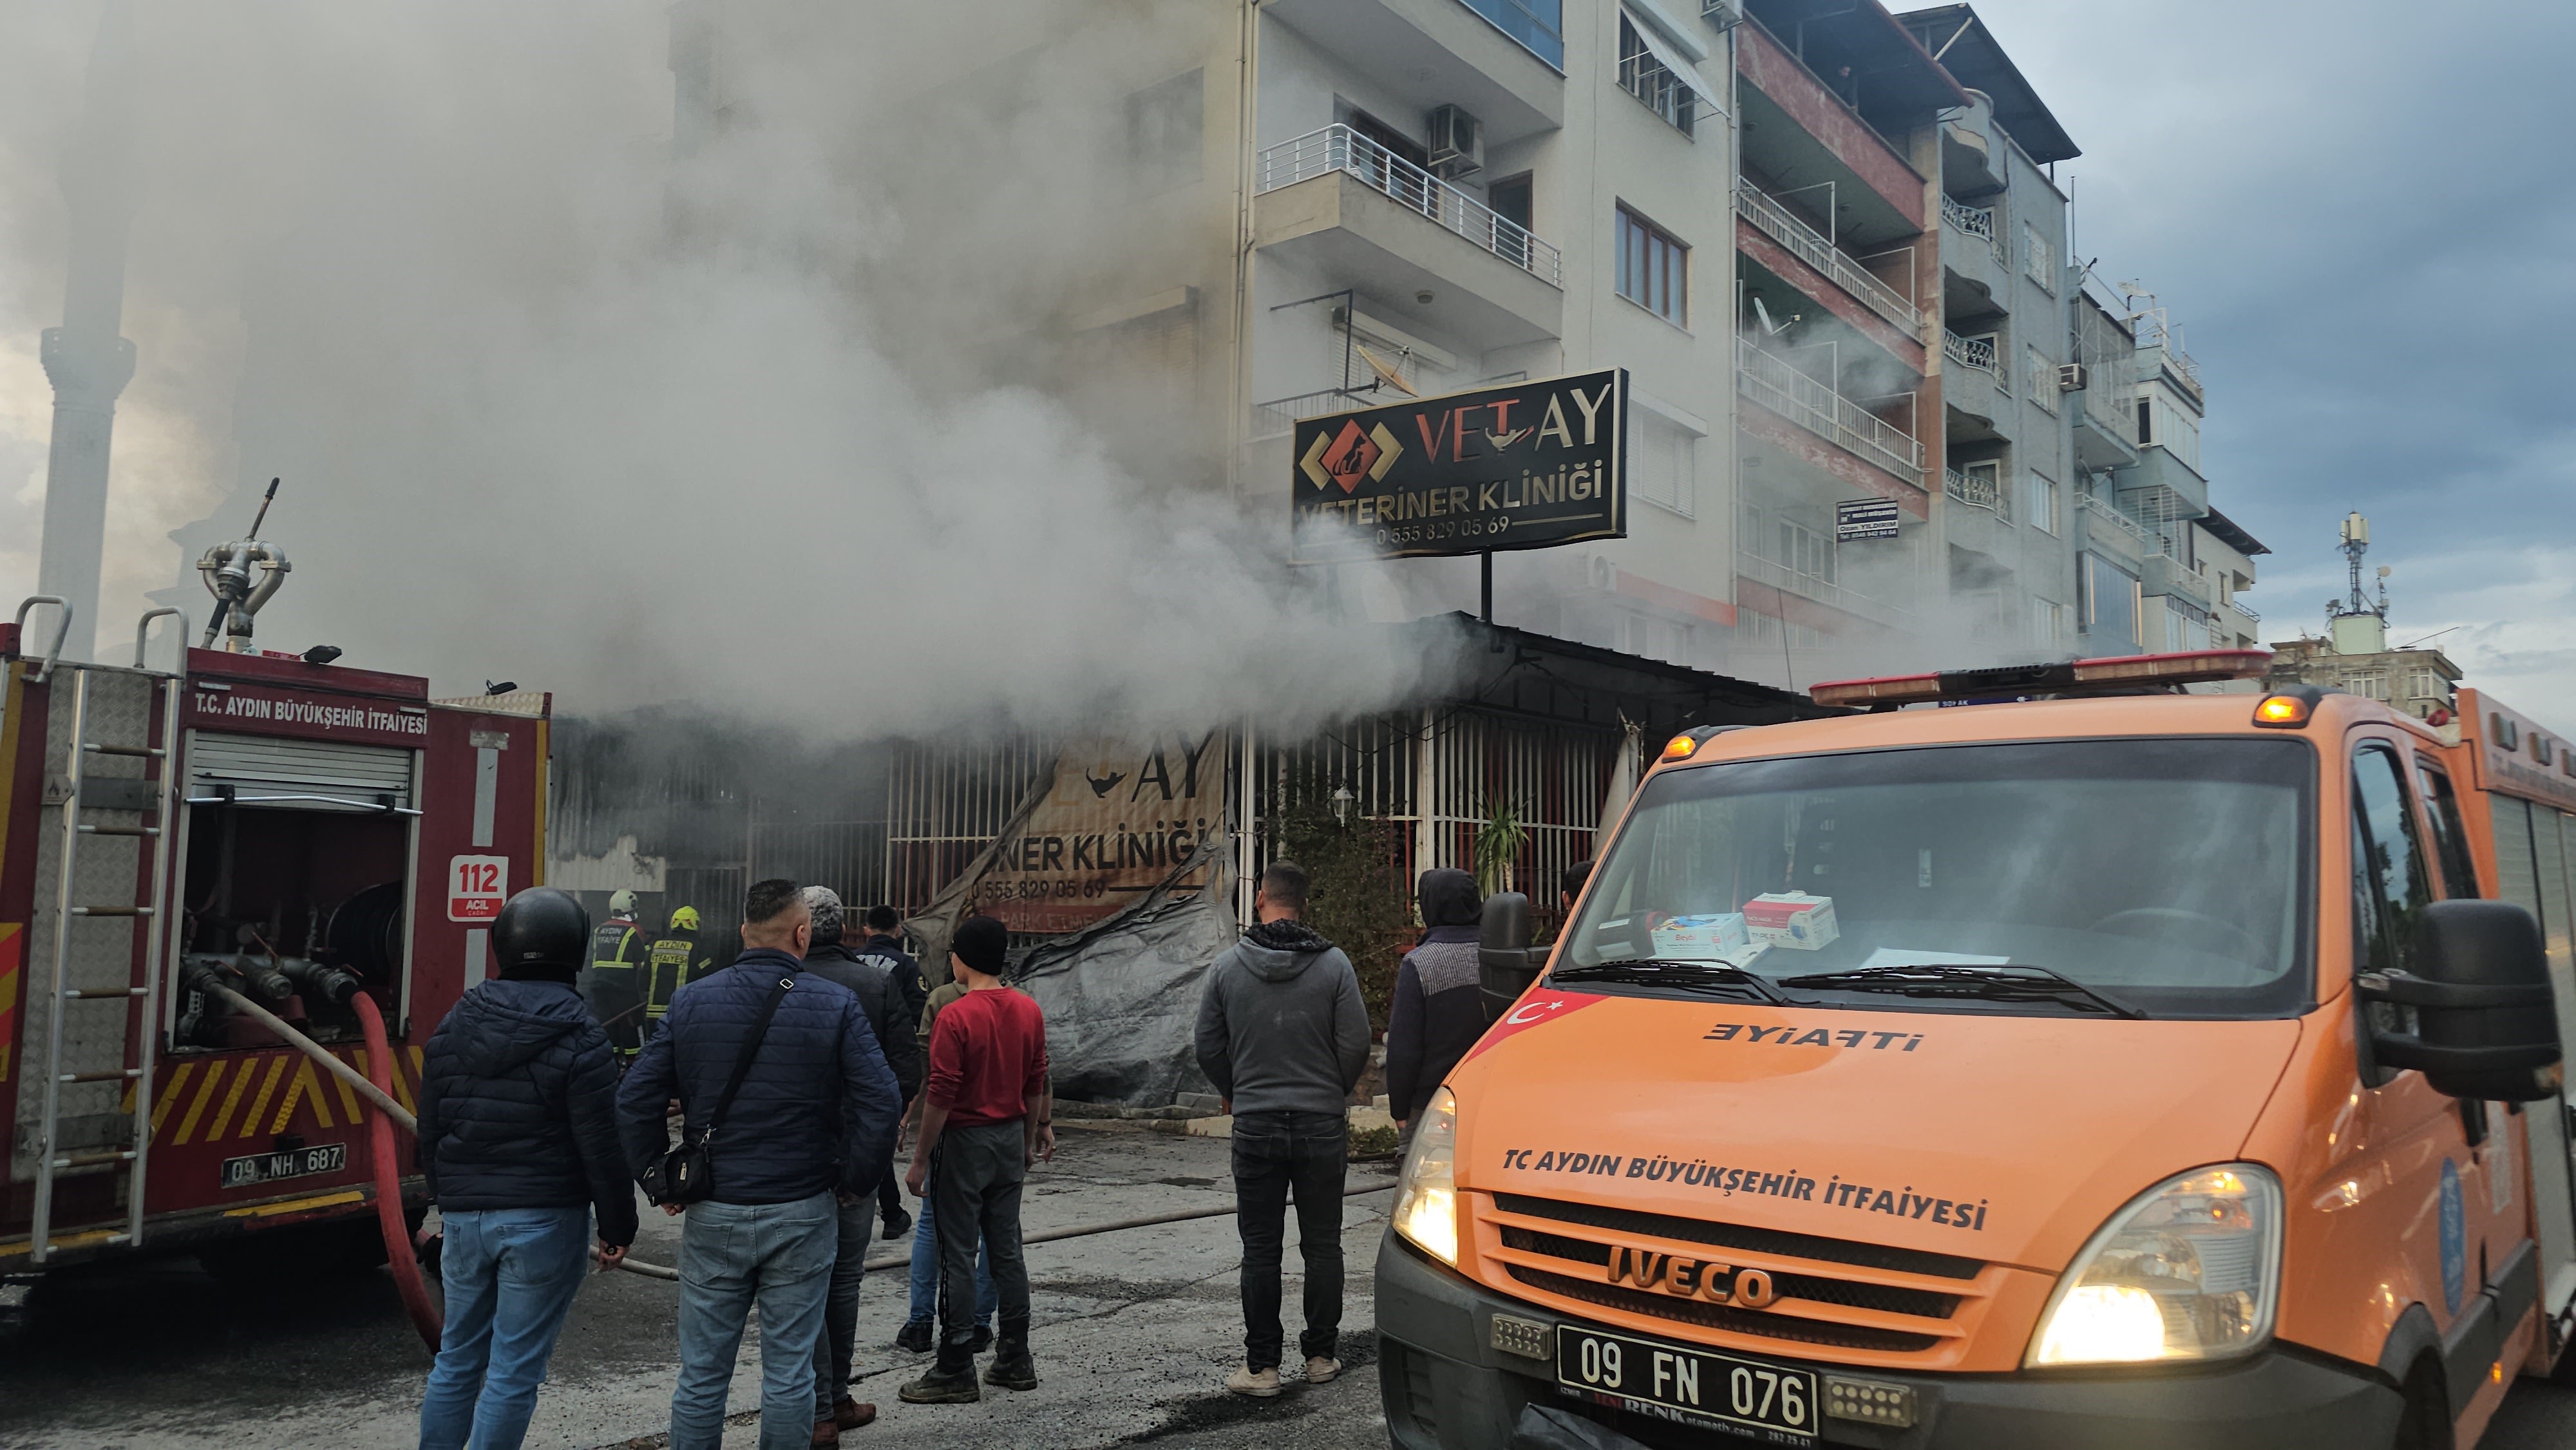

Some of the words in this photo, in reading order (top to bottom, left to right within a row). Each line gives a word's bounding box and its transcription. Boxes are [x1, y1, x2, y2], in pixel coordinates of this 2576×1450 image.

[1479, 459, 1602, 511] KLİNİĞİ
[1376, 529, 1387, 545] 0
[1391, 525, 1421, 543] 555
[1426, 522, 1455, 540] 829
[1461, 518, 1482, 536] 05
[1488, 516, 1509, 534] 69
[196, 693, 222, 714] T.C.
[225, 696, 271, 719] AYDIN
[274, 699, 365, 730] BÜYÜKŞEHİR
[368, 706, 428, 735] İTFAİYESİ
[460, 864, 498, 892] 112
[985, 881, 1013, 899] 555
[1019, 880, 1050, 899] 829
[1056, 880, 1077, 898] 05
[1084, 879, 1105, 898] 69
[659, 941, 687, 950] AYDIN
[232, 1160, 255, 1182] 09
[270, 1154, 294, 1178] NH
[307, 1147, 340, 1171] 687
[1502, 1149, 1533, 1171] TC
[1535, 1150, 1623, 1177] AYDIN
[1626, 1154, 1815, 1201] BÜYÜKŞEHİR
[1823, 1174, 1989, 1231] İTFAİYESİ
[1607, 1246, 1774, 1308] IVECO
[1581, 1338, 1622, 1388] 09
[1653, 1351, 1699, 1406] FN
[1731, 1367, 1805, 1426] 076
[1625, 1398, 1685, 1424] RENK
[1687, 1417, 1755, 1438] otomotiv.com
